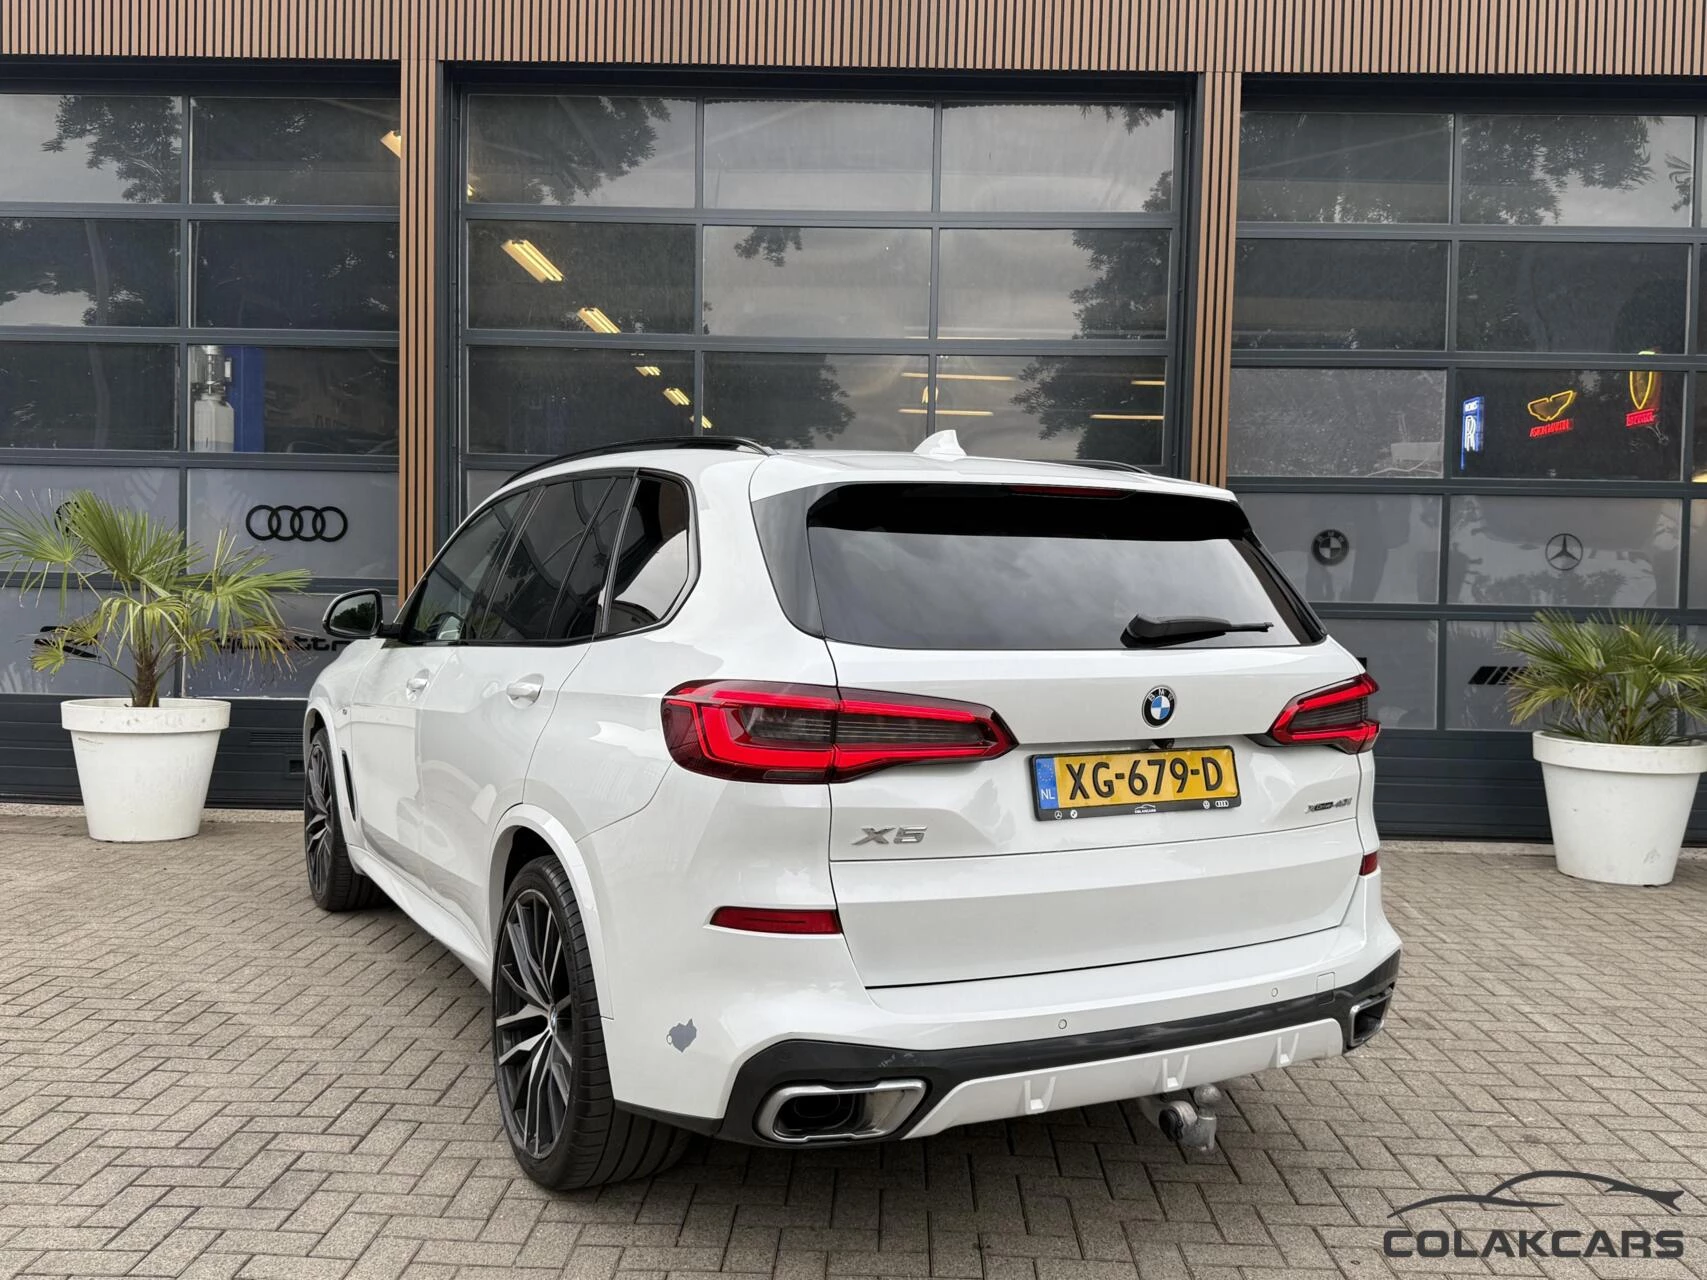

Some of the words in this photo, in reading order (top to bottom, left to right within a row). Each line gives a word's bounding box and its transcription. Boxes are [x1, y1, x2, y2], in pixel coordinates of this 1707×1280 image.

[1065, 756, 1224, 800] XG-679-D
[1040, 788, 1056, 800] NL
[851, 826, 928, 846] X5
